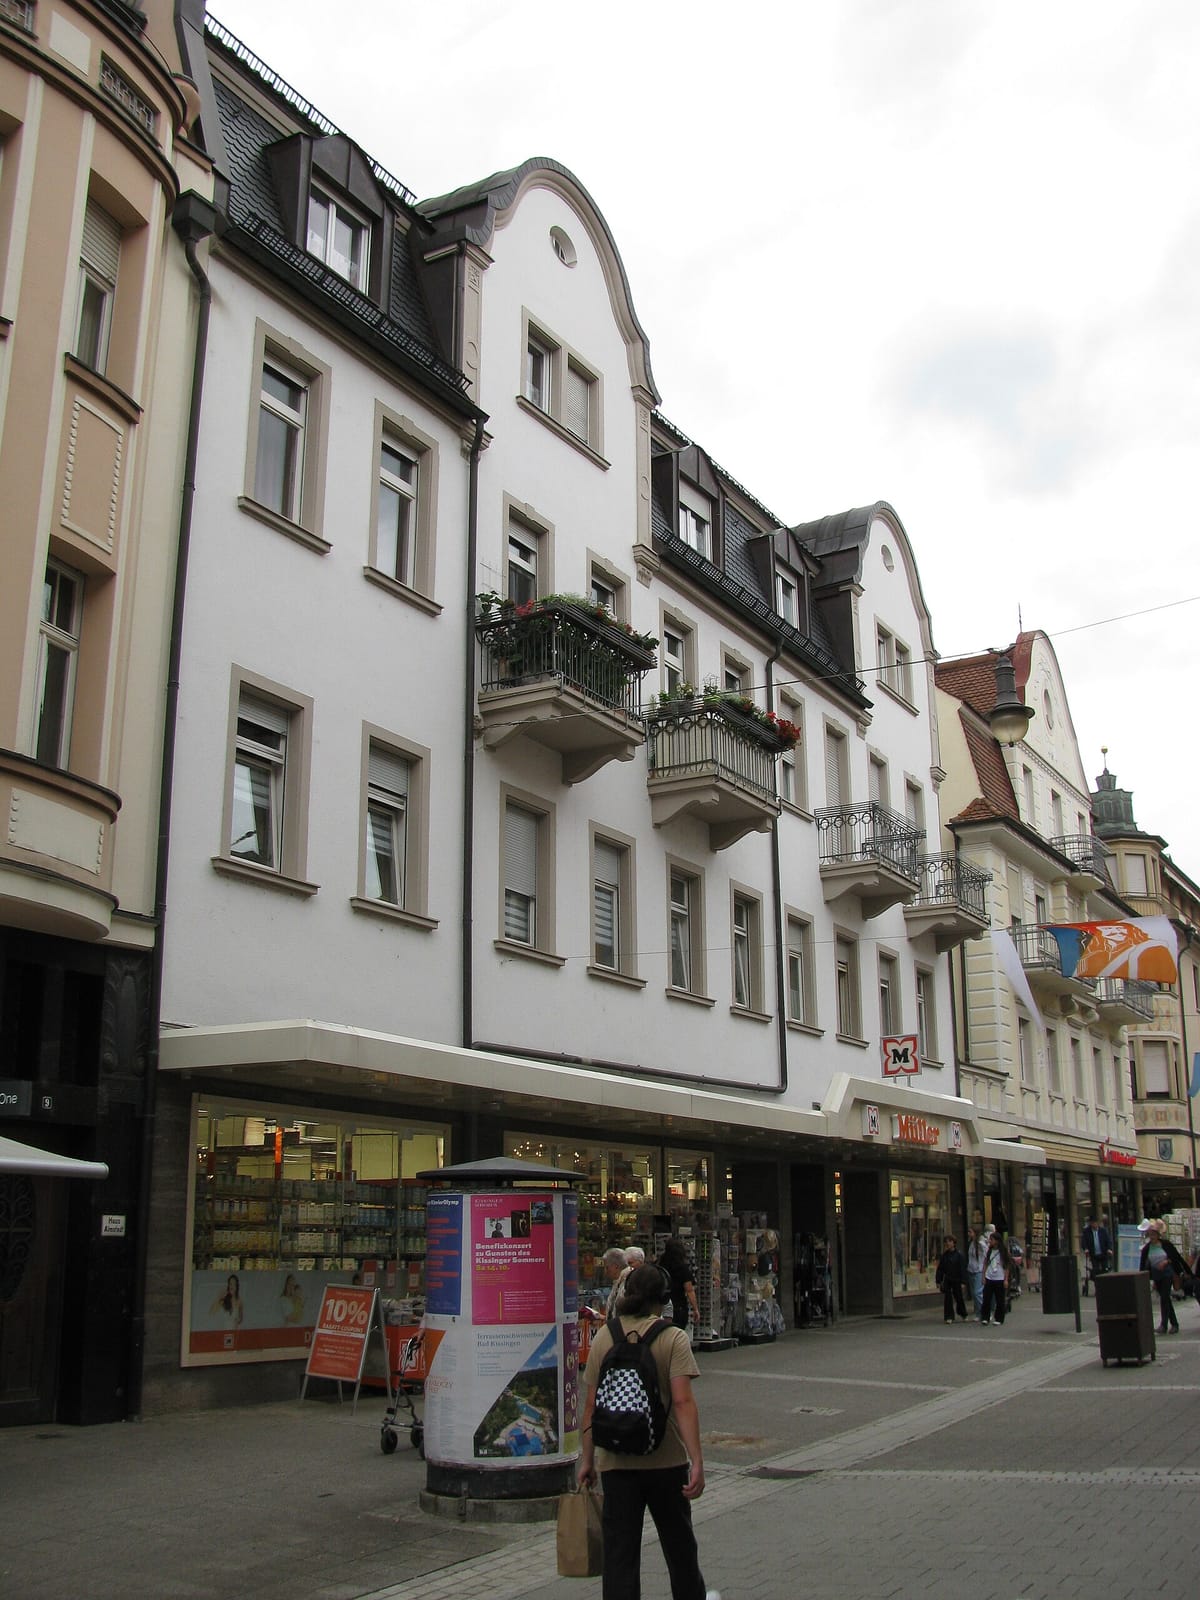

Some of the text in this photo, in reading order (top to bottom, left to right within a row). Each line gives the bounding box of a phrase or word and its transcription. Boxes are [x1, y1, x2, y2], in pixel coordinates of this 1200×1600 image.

[891, 1047, 910, 1064] M
[44, 1098, 50, 1107] 9
[897, 1113, 939, 1145] Müller
[475, 1242, 532, 1250] Benefizkonzert
[485, 1249, 517, 1257] Gunsten
[475, 1256, 545, 1265] Kissinger Sommers
[326, 1298, 368, 1325] 10%
